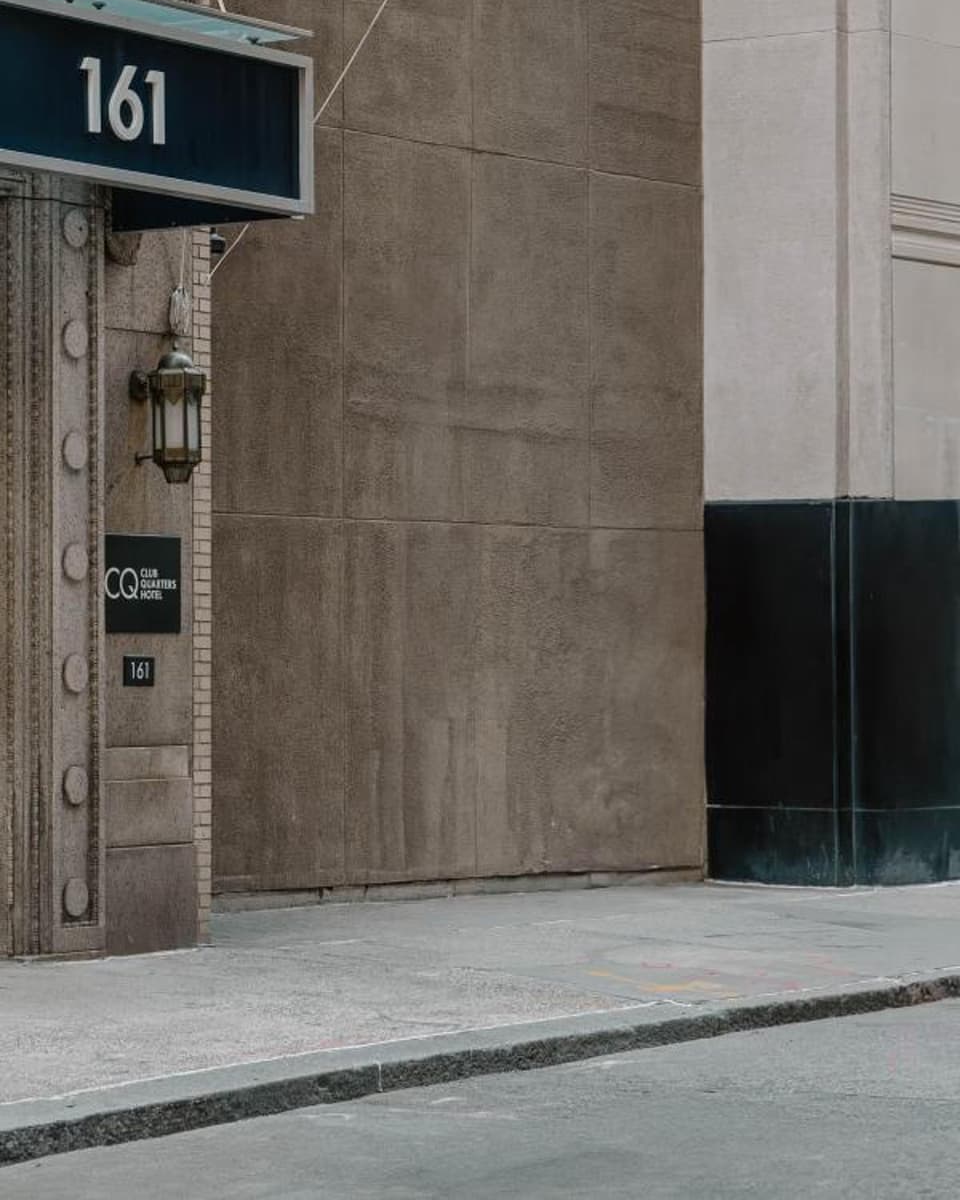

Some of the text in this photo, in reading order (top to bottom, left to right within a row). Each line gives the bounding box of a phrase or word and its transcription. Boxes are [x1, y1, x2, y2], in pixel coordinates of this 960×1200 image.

[80, 56, 166, 146] 161
[141, 568, 158, 578] CLUB
[105, 566, 138, 600] CQ
[141, 579, 176, 589] QUARTERS
[141, 590, 162, 600] HOTEL
[130, 661, 150, 680] 161
